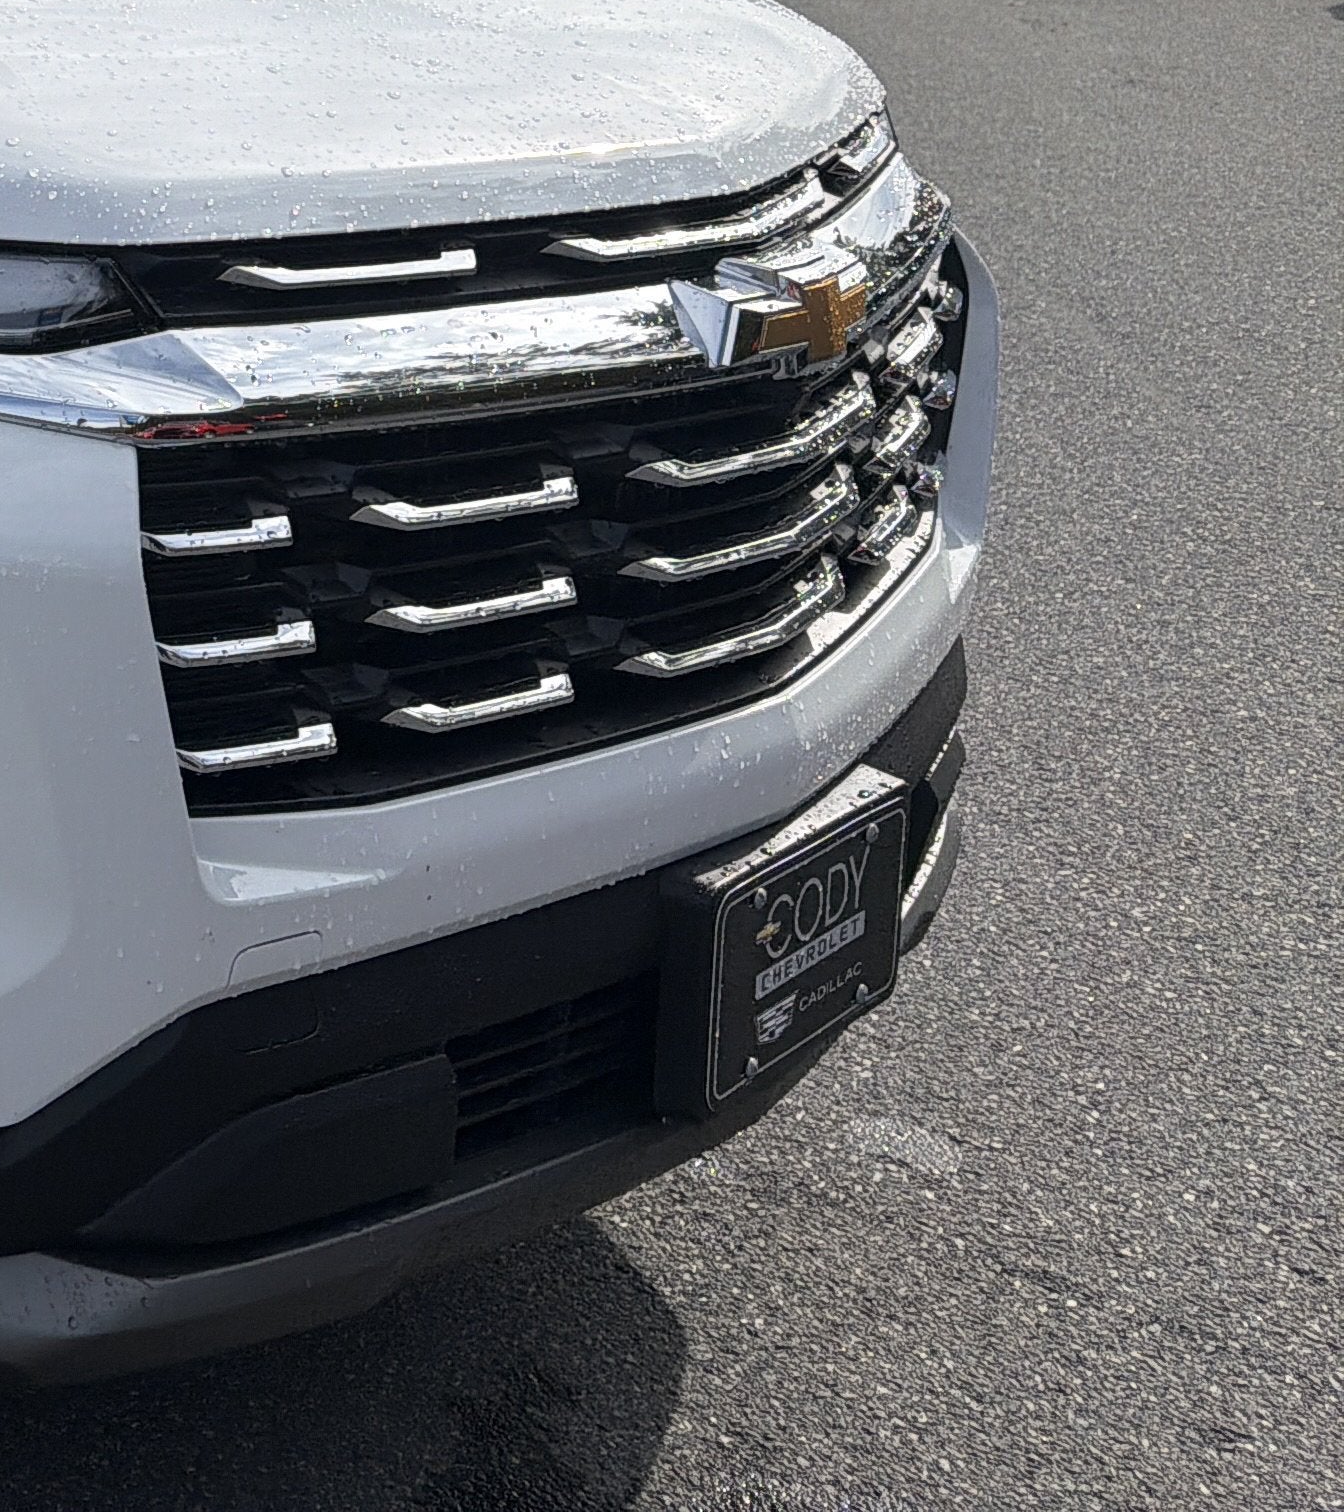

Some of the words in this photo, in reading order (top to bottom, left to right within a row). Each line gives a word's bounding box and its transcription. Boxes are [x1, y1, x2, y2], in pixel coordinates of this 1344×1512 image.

[765, 845, 870, 958] CODY
[761, 918, 861, 989] CHEVROLET
[798, 962, 862, 1011] CADILLAC
